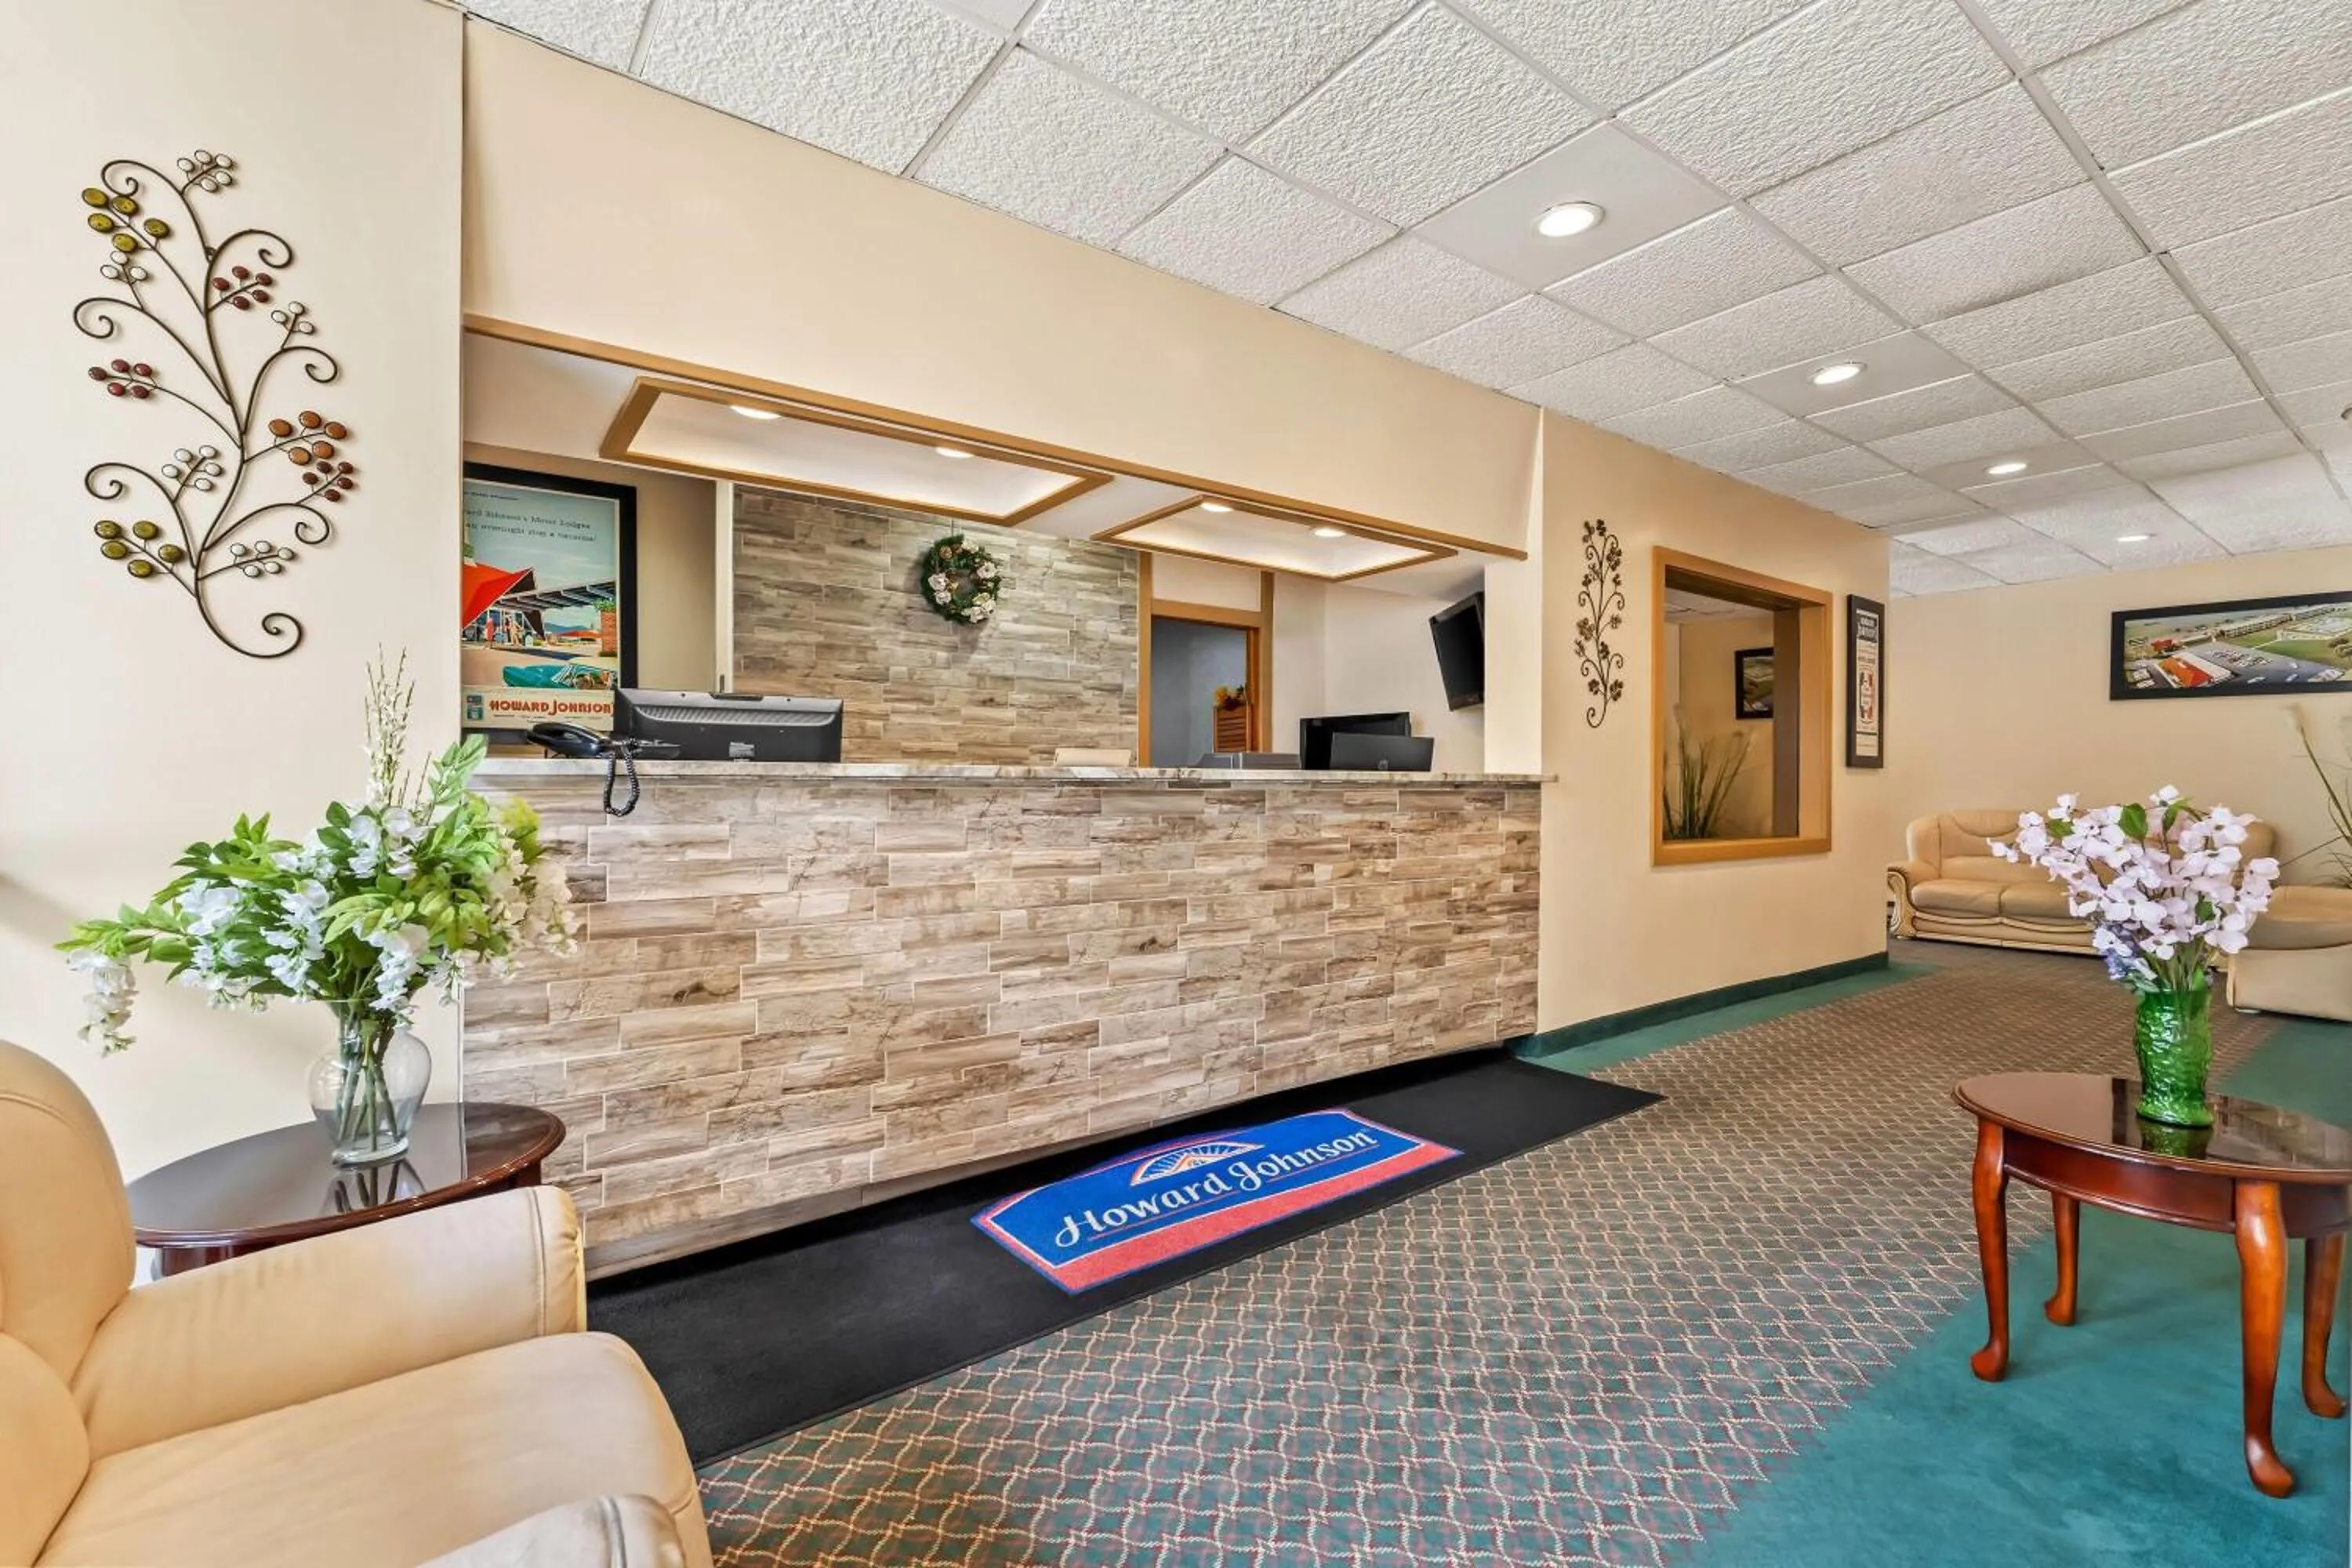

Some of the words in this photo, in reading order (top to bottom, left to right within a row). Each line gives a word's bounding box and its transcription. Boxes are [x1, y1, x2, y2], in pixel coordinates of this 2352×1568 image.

[489, 699, 549, 712] HOWARD
[548, 699, 611, 716] JOHNSON
[1054, 1172, 1233, 1247] Howard
[1228, 1130, 1377, 1192] Johnson
